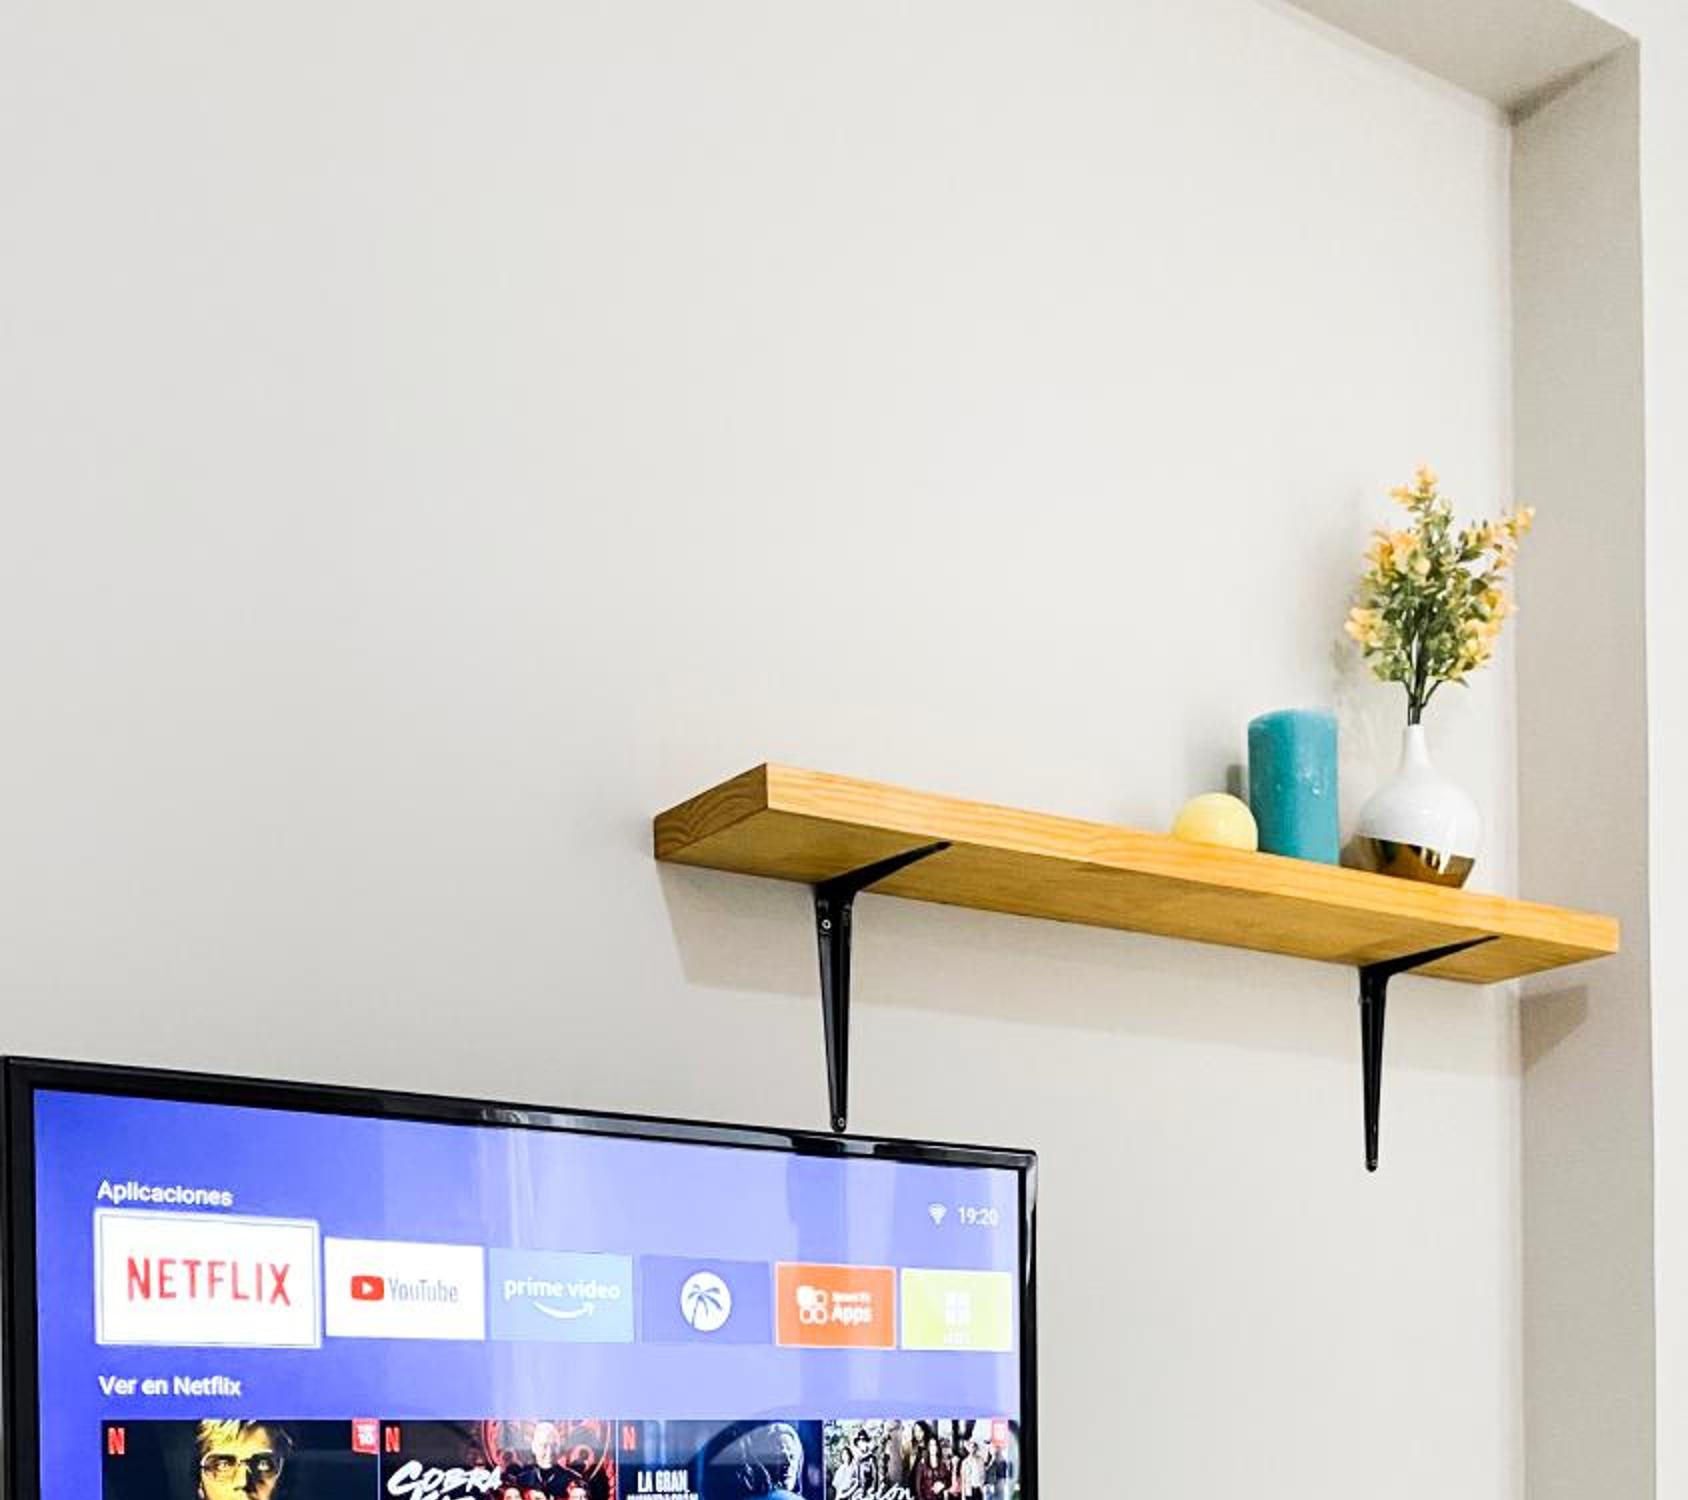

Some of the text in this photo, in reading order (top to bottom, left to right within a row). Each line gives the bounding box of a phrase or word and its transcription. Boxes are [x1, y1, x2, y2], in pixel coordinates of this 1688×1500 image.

[97, 1180, 234, 1206] Aplicaciones
[958, 1207, 998, 1226] 19:20
[127, 1257, 291, 1307] NETFLIX
[388, 1278, 459, 1303] YouTube
[504, 1278, 622, 1300] prime video
[831, 1307, 872, 1326] Apps
[99, 1376, 241, 1396] Ver en Netflix
[637, 1471, 653, 1493] LA
